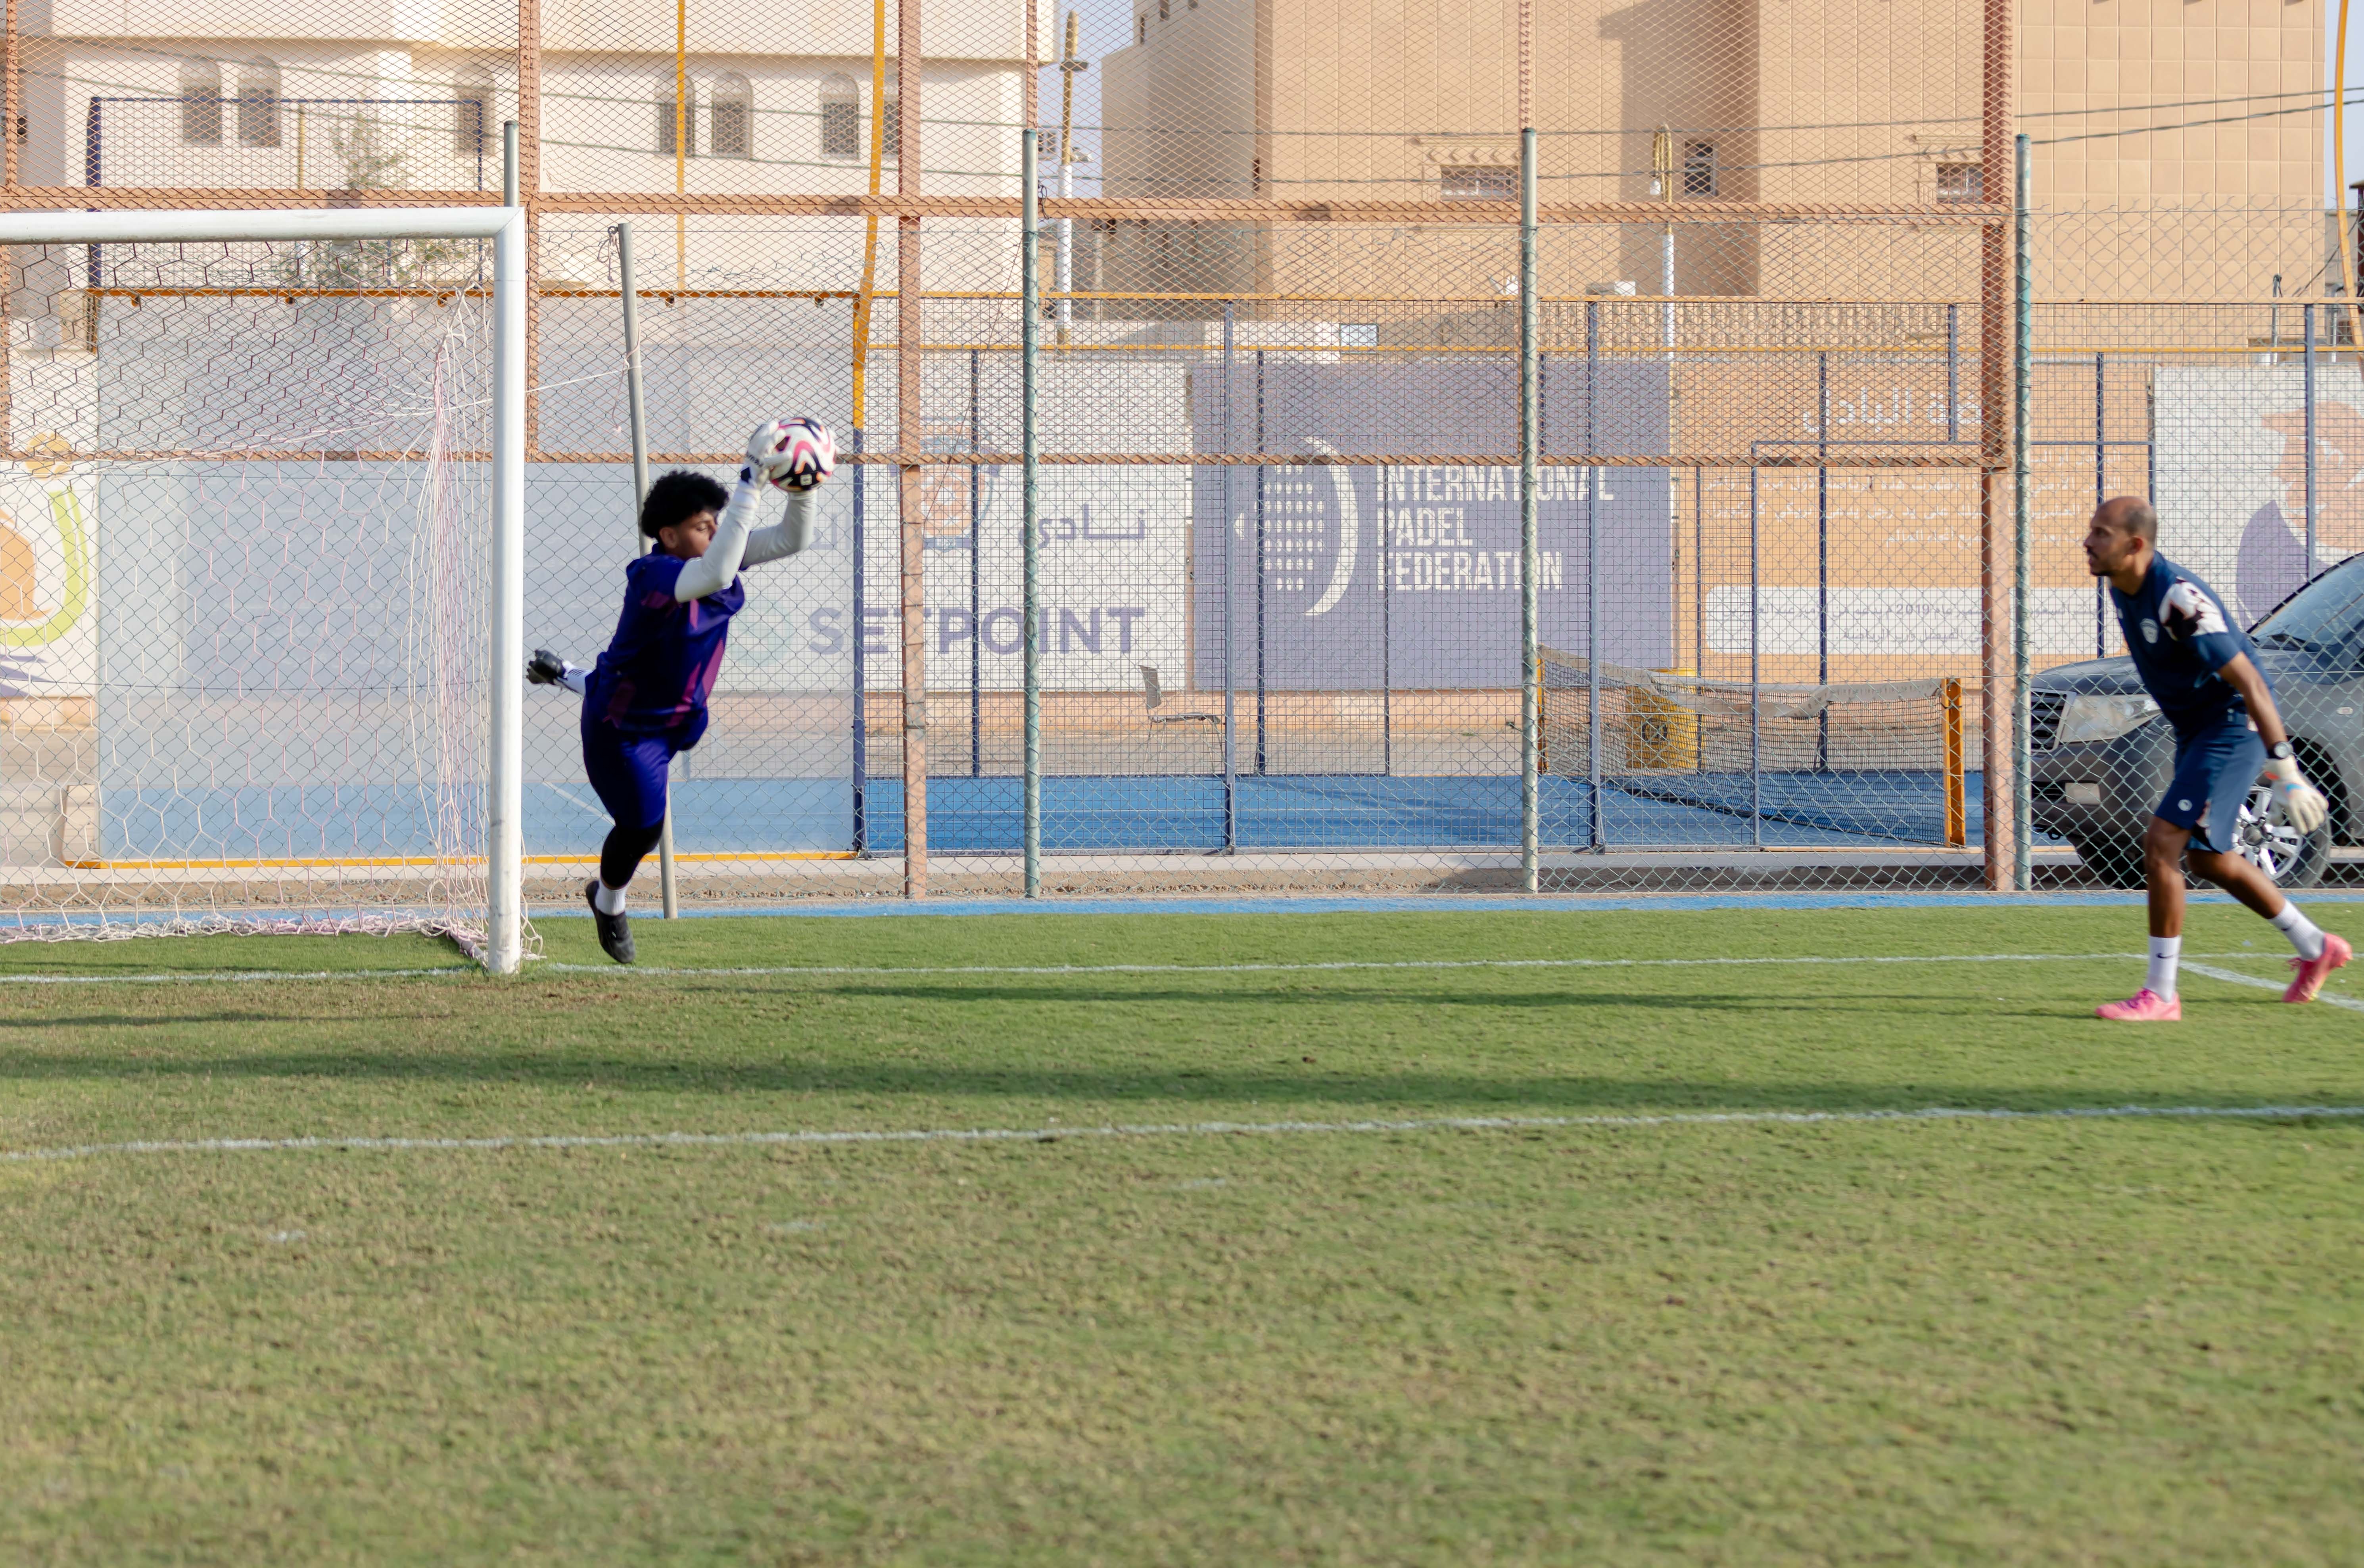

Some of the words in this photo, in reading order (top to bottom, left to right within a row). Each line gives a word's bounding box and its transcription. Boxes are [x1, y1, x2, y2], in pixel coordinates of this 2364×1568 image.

[1377, 464, 1614, 501] INTERNATONAL
[1377, 507, 1473, 547] PADEL
[1377, 551, 1563, 590] FEDERATIN
[1896, 603, 1930, 615] 2019
